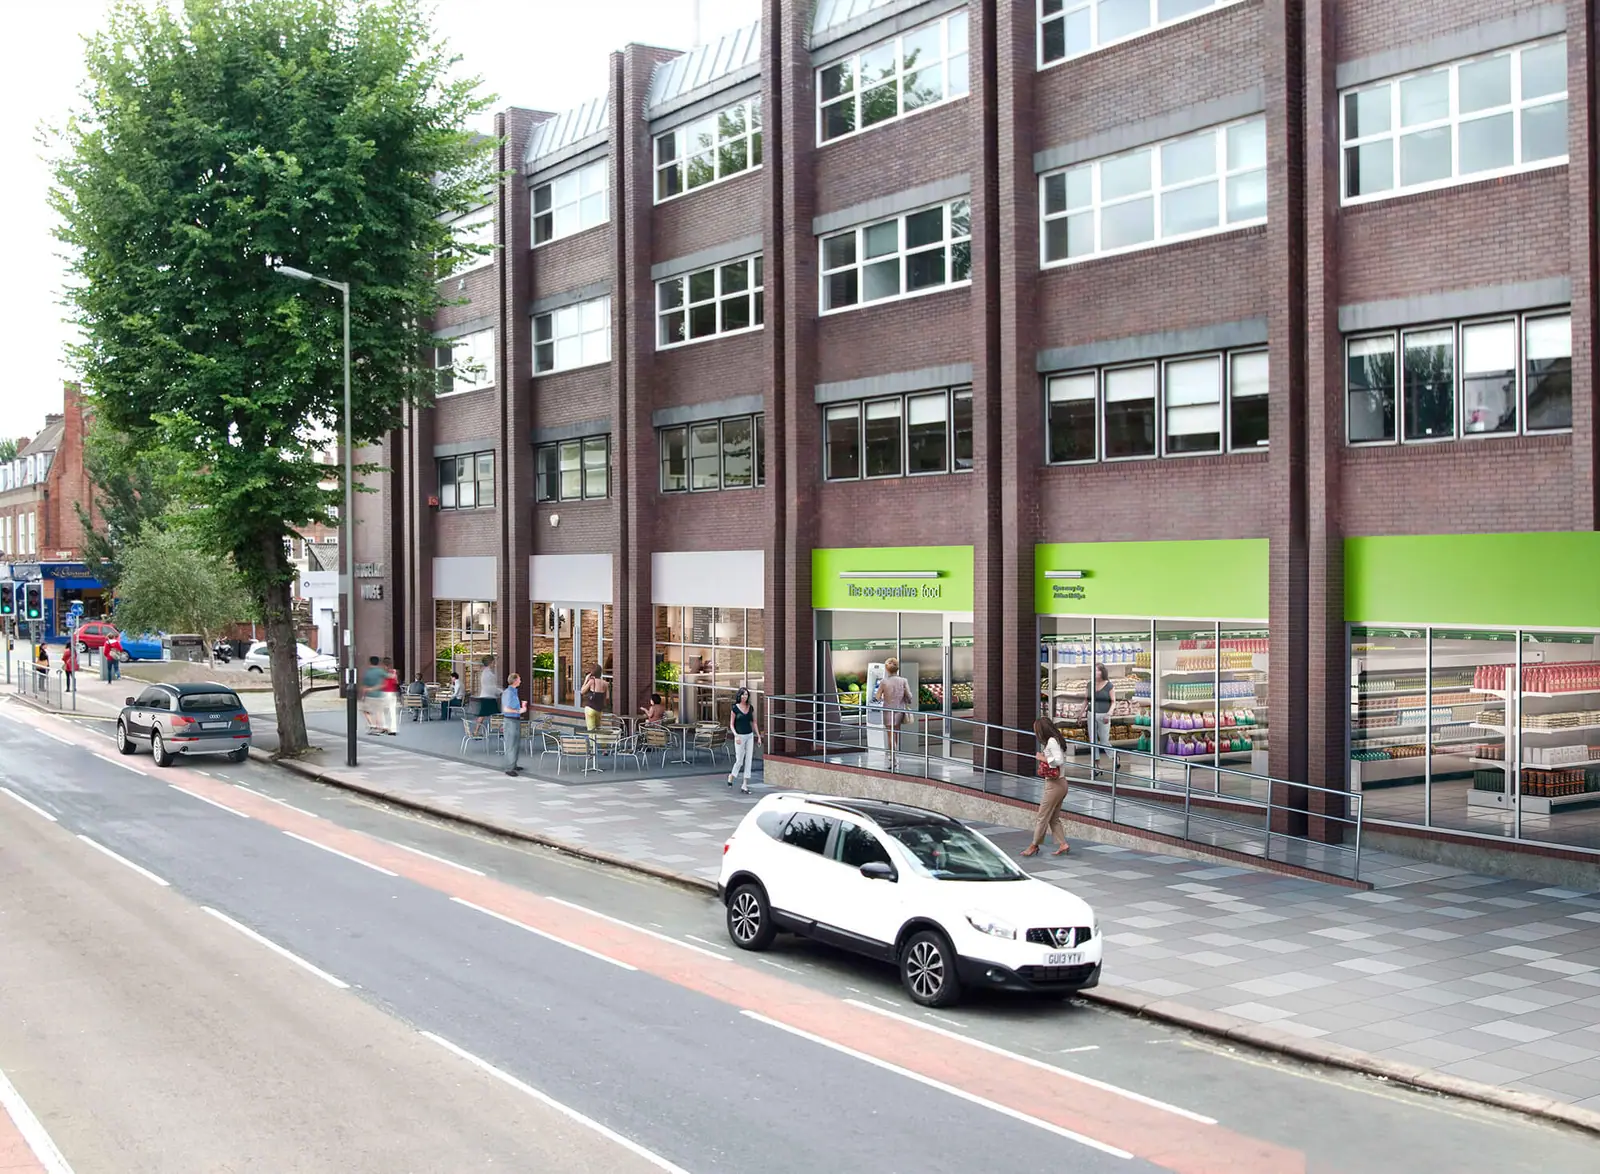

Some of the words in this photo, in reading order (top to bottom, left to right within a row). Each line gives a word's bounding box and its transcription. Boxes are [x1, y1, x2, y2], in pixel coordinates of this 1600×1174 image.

[847, 584, 861, 596] The
[863, 584, 917, 599] co-operative
[921, 584, 941, 597] food
